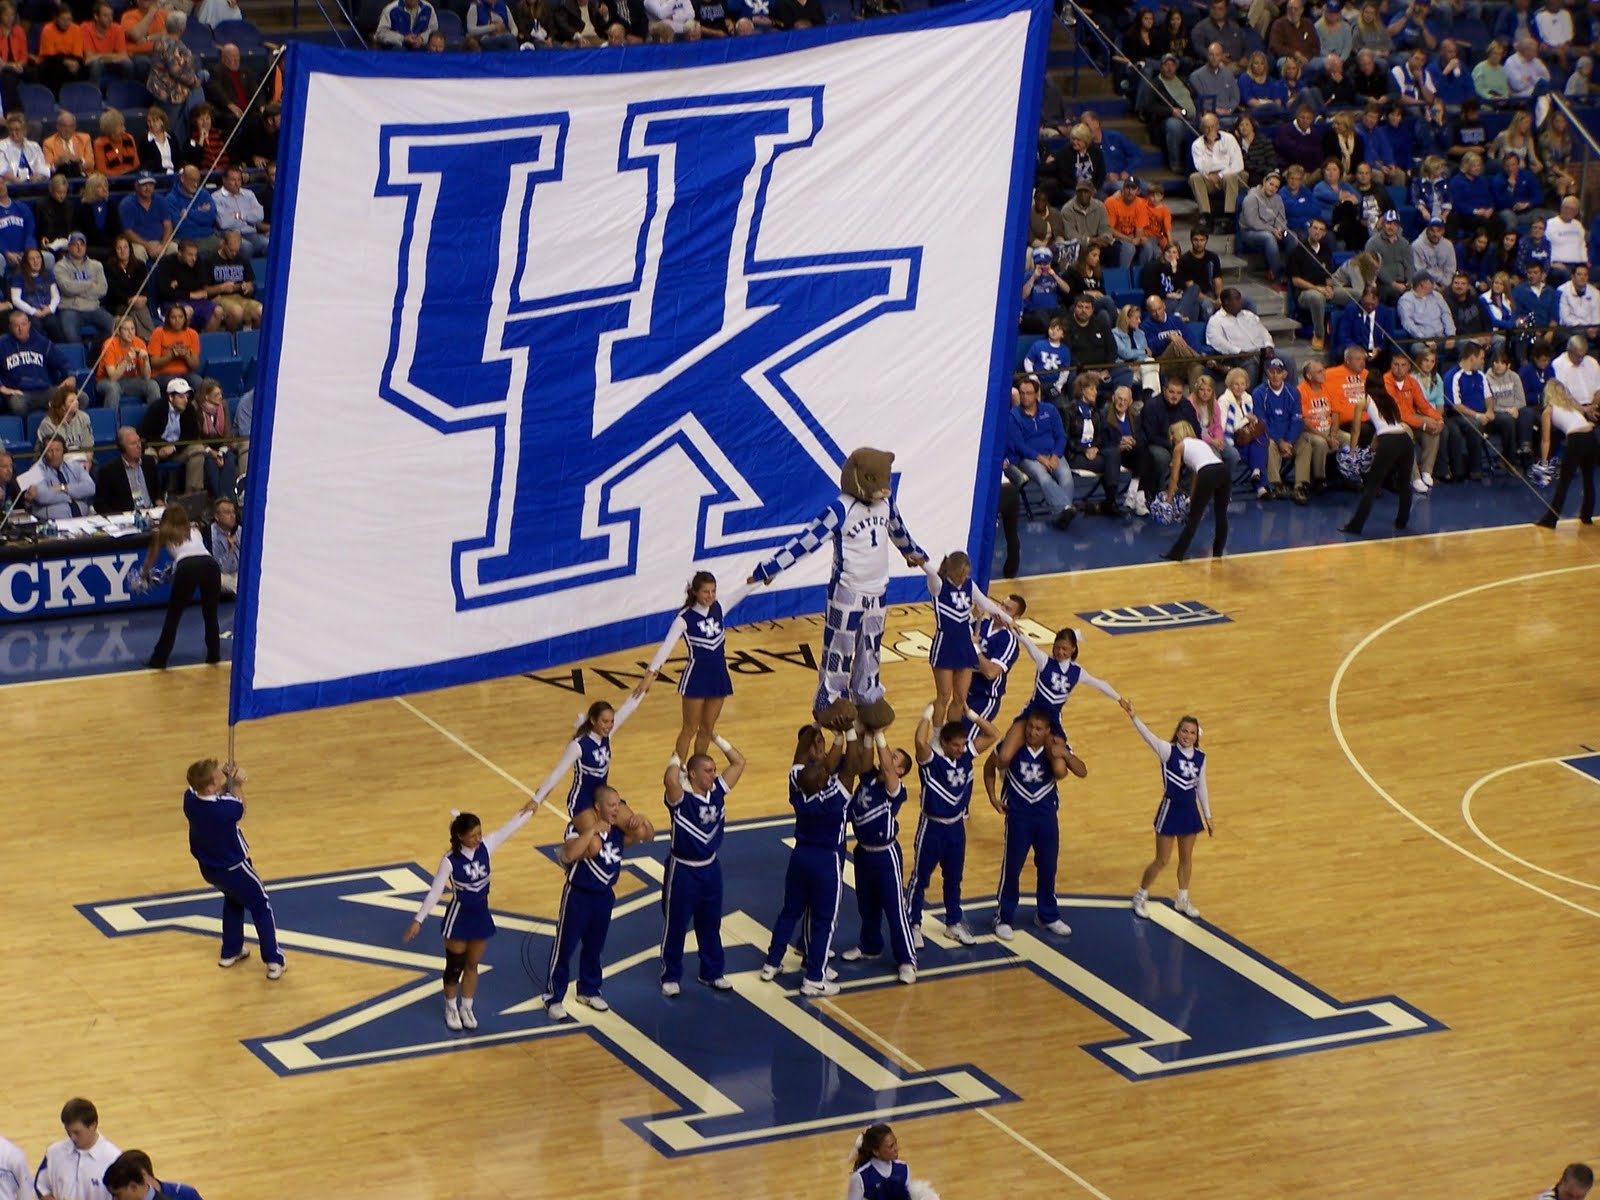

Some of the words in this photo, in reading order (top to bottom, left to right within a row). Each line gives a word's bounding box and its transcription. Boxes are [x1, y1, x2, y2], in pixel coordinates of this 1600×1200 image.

[375, 84, 923, 613] UK
[1041, 351, 1061, 371] UK
[870, 528, 878, 548] 1
[950, 591, 970, 609] UK
[697, 617, 721, 638] UK
[522, 643, 819, 696] ARNA
[1051, 672, 1070, 693] UK
[592, 746, 609, 766] UK
[945, 767, 965, 787] UK
[1020, 761, 1045, 783] UK
[1179, 759, 1199, 778] UK
[699, 805, 719, 824] UK
[463, 861, 487, 881] UK
